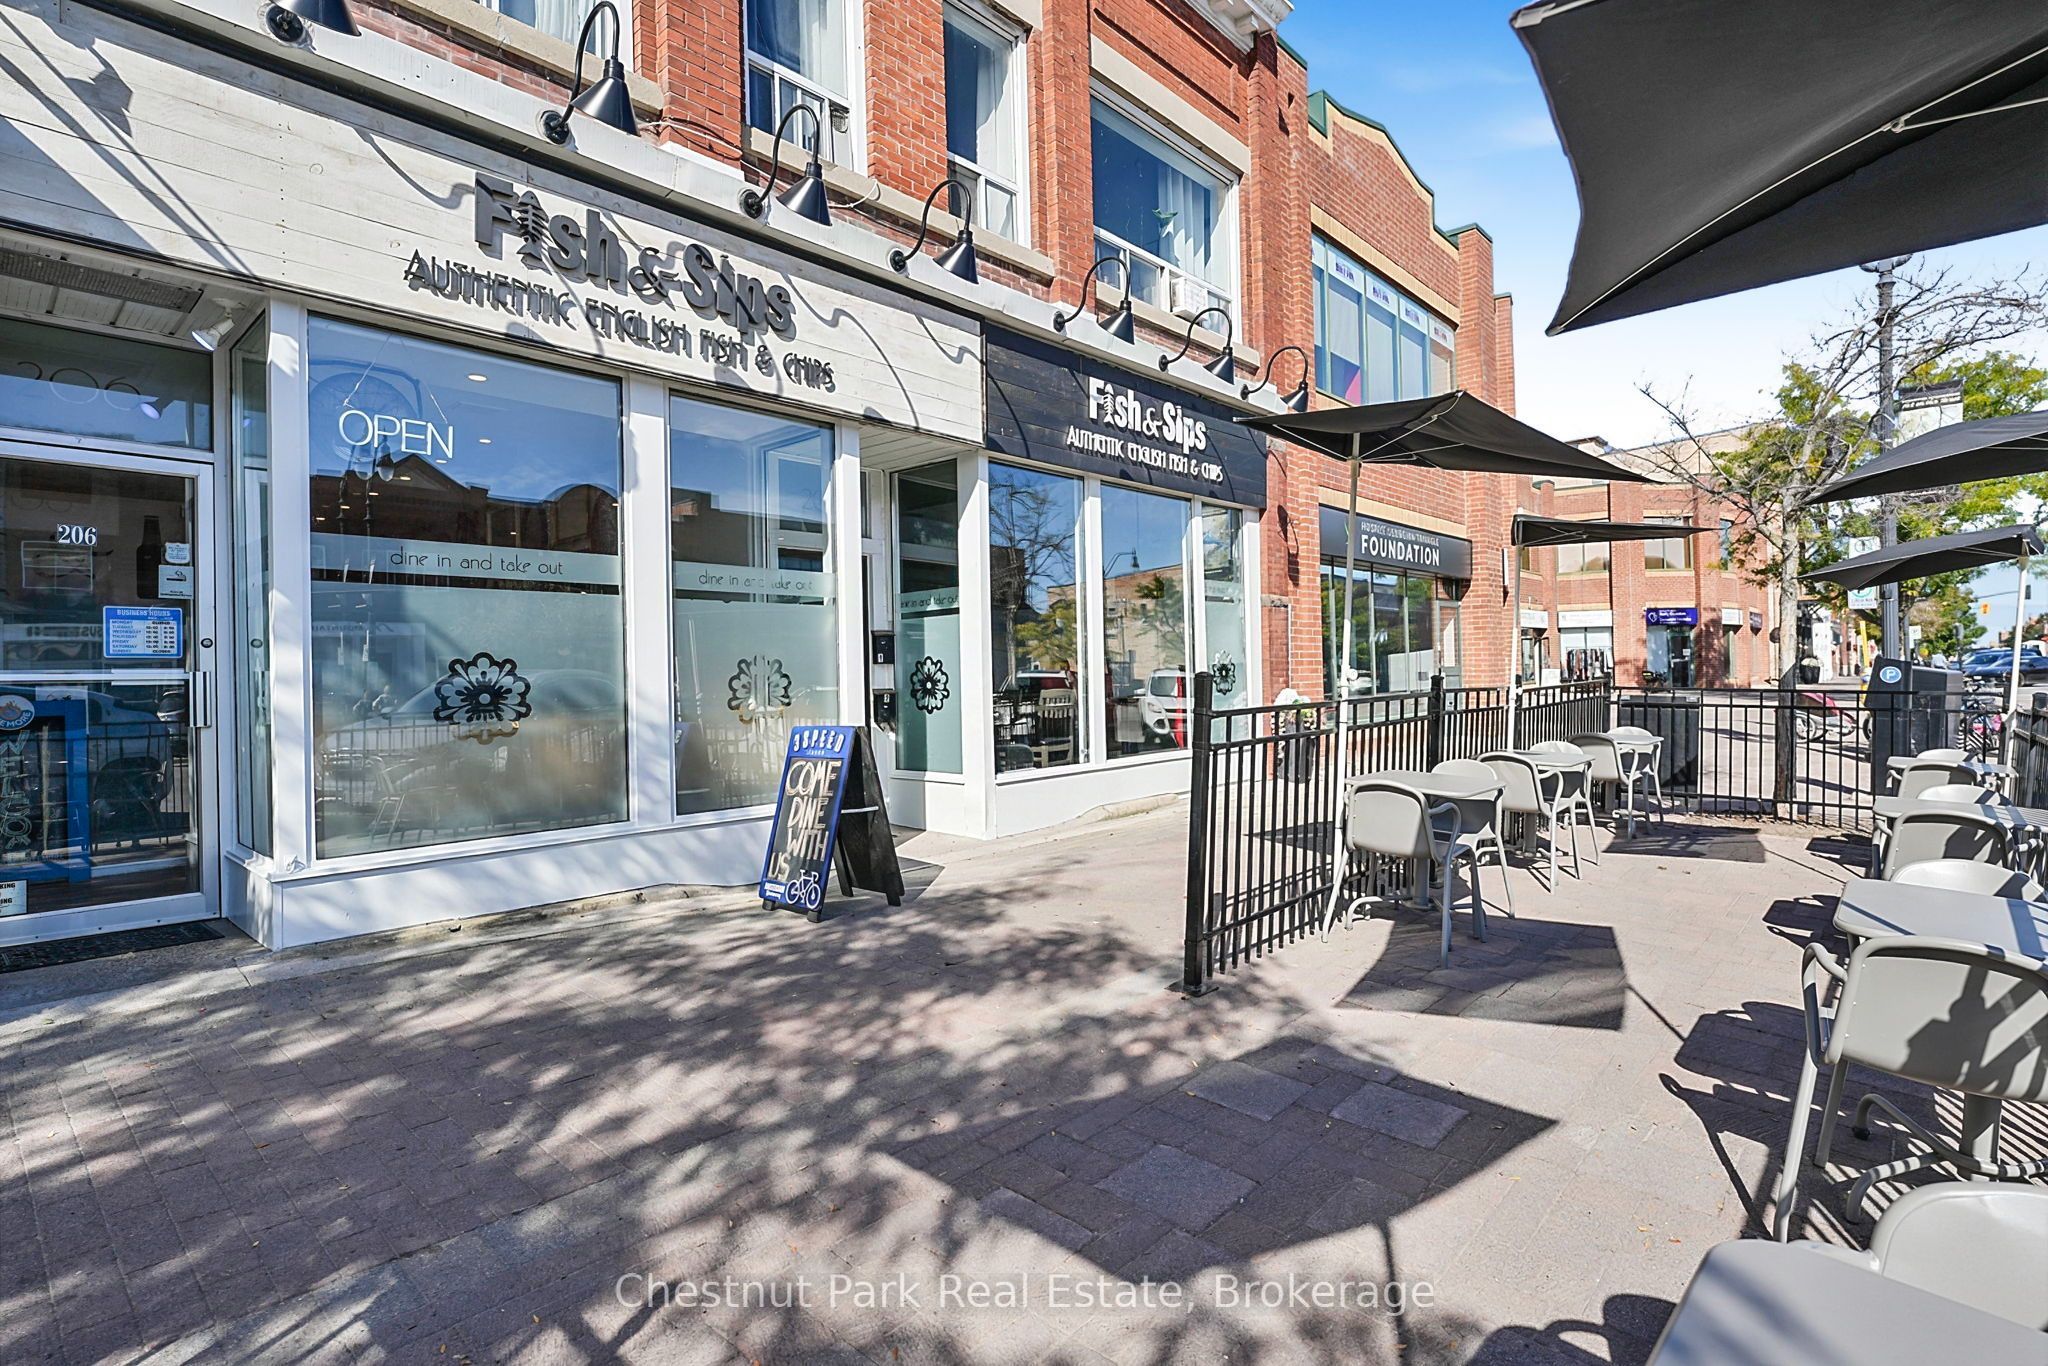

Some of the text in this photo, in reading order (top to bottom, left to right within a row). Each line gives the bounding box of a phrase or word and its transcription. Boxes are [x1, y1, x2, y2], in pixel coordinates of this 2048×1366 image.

[475, 172, 793, 335] Fish & Sips
[700, 328, 749, 371] FISH
[755, 344, 774, 376] &
[783, 352, 837, 392] CHIPS
[1088, 376, 1207, 455] Fish & Sips
[339, 409, 453, 459] OPEN
[1168, 453, 1188, 476] FISH
[1190, 459, 1201, 476] &
[57, 524, 98, 546] 206
[1361, 534, 1440, 567] FOUNDATION
[390, 546, 563, 575] dine in and take out
[698, 568, 724, 585] dine
[729, 575, 739, 586] in
[1886, 669, 1896, 680] P
[802, 729, 845, 753] SPEED
[785, 759, 842, 797] COME
[787, 796, 829, 830] DINE
[786, 827, 830, 862] WITH
[768, 851, 791, 883] US
